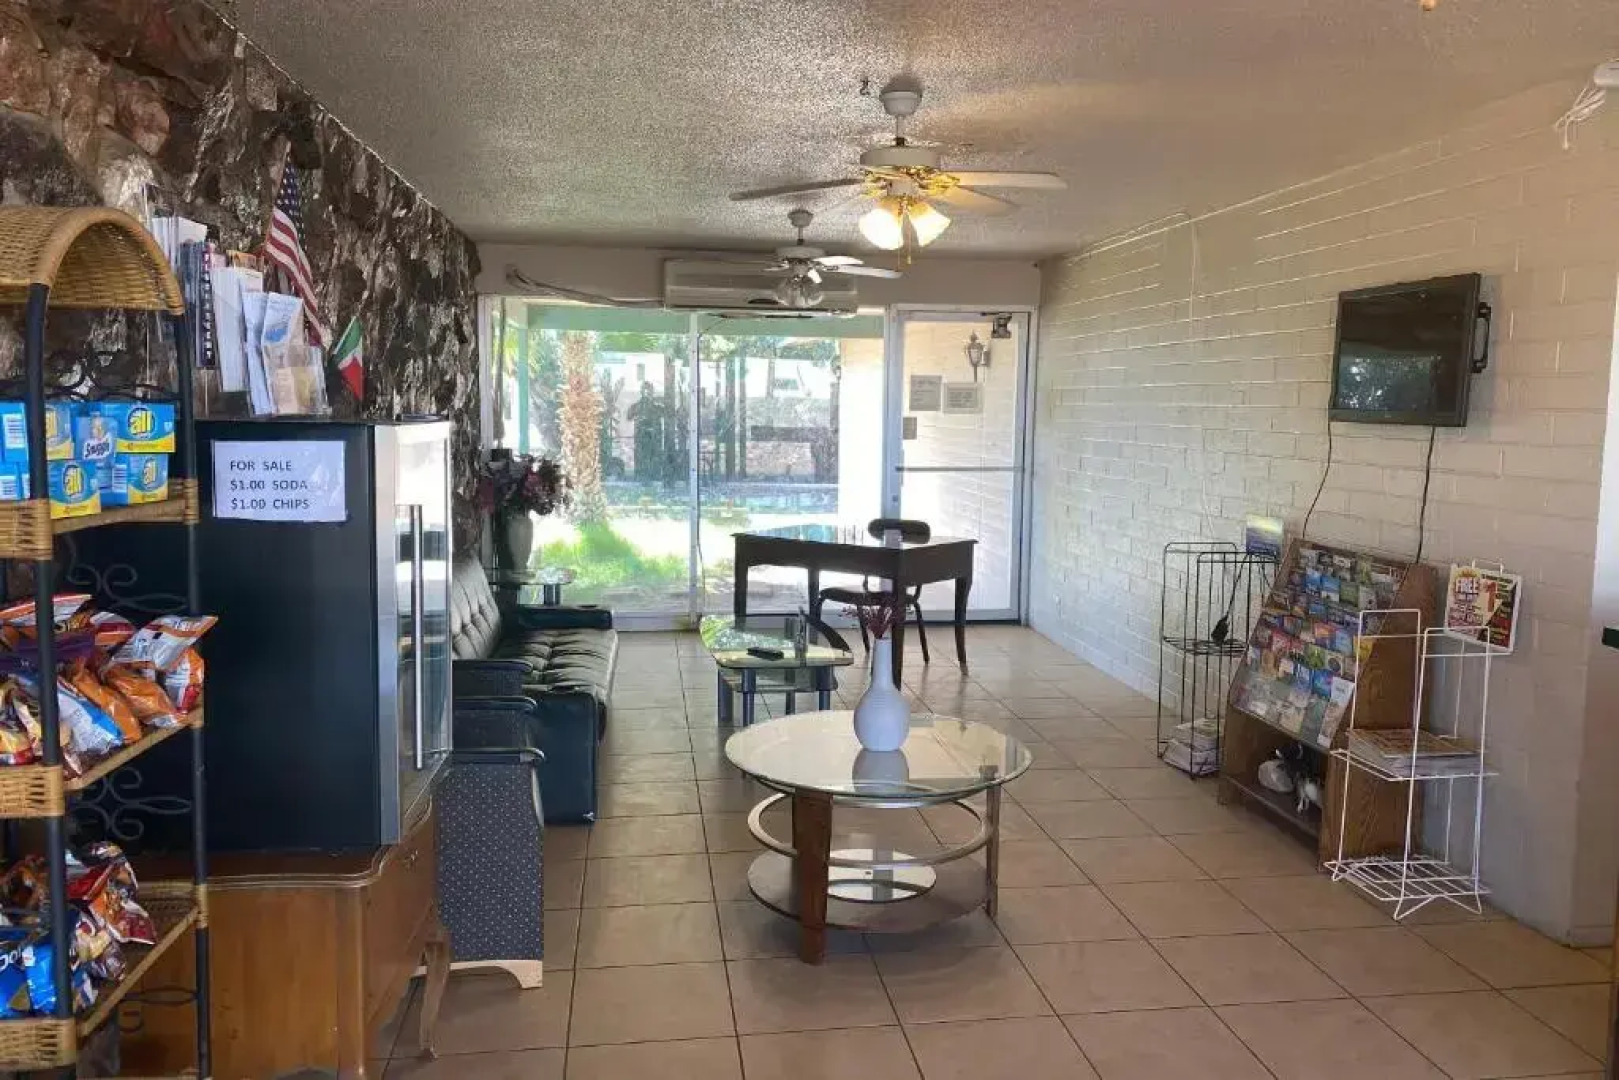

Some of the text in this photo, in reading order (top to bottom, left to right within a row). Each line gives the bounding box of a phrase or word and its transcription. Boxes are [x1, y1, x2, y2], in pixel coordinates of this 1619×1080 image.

[129, 409, 152, 435] all
[144, 458, 157, 485] all
[230, 460, 292, 471] FOR SALE
[65, 466, 83, 496] all
[230, 479, 308, 491] $1.00 SODA
[231, 498, 310, 510] $1.00 CHIPS
